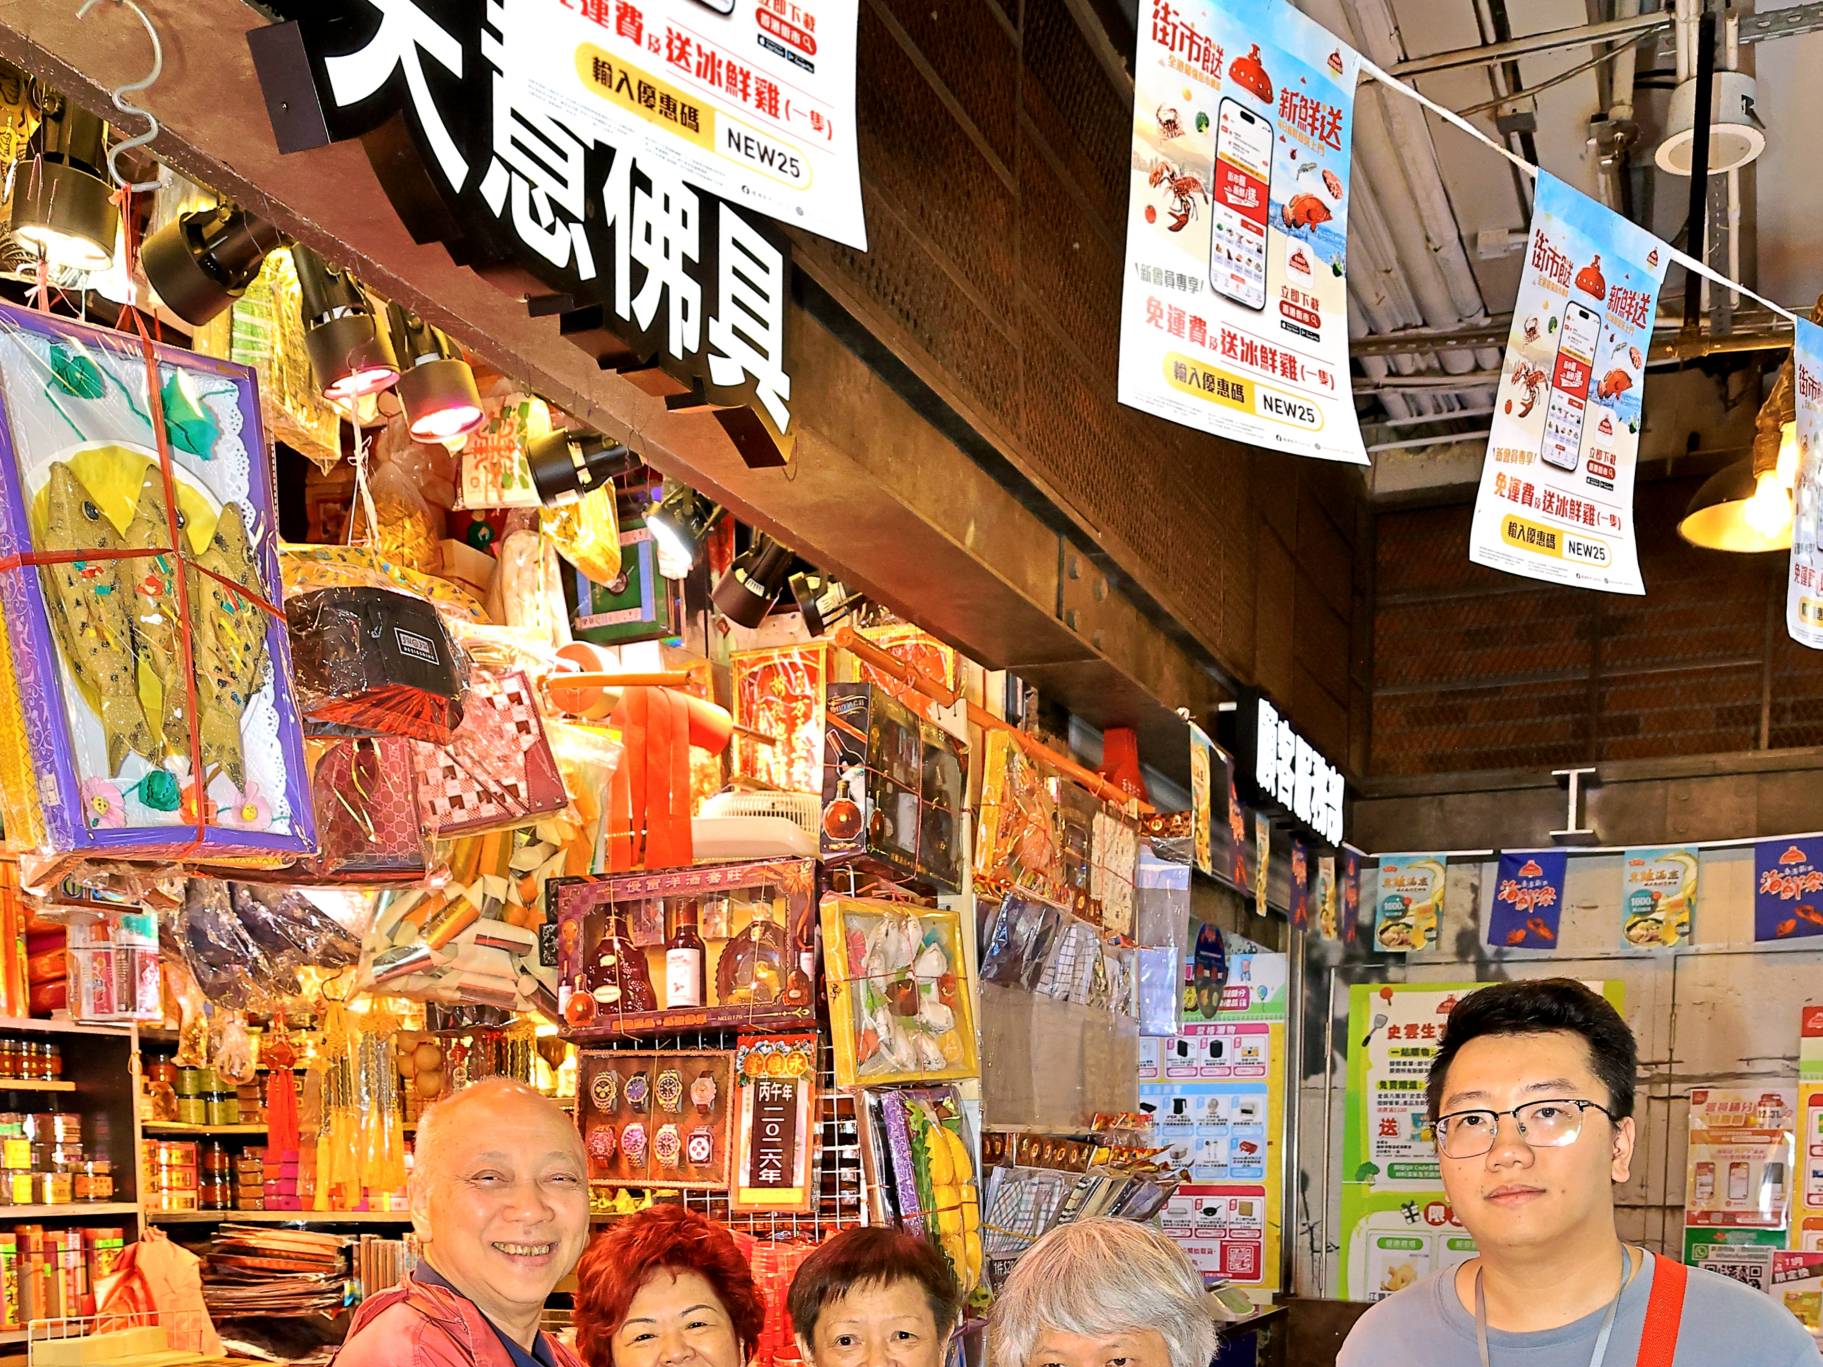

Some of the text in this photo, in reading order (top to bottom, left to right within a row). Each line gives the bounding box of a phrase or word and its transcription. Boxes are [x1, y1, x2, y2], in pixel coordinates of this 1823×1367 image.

[560, 0, 832, 141] 運費及送冰鮮雞(一隻)
[592, 57, 699, 133] 輸入優惠碼
[1278, 88, 1343, 151] 新鮮送
[727, 128, 800, 178] NEW25
[1281, 285, 1319, 312] 立即下載
[1607, 285, 1651, 330] 新鮮送
[1173, 360, 1245, 403] 輸入優惠碼
[1798, 362, 1823, 401] 街市
[1263, 394, 1315, 424] NEW25
[1568, 540, 1606, 561] NEW25
[758, 1081, 793, 1102] 丙午年
[1378, 1117, 1398, 1137] 送
